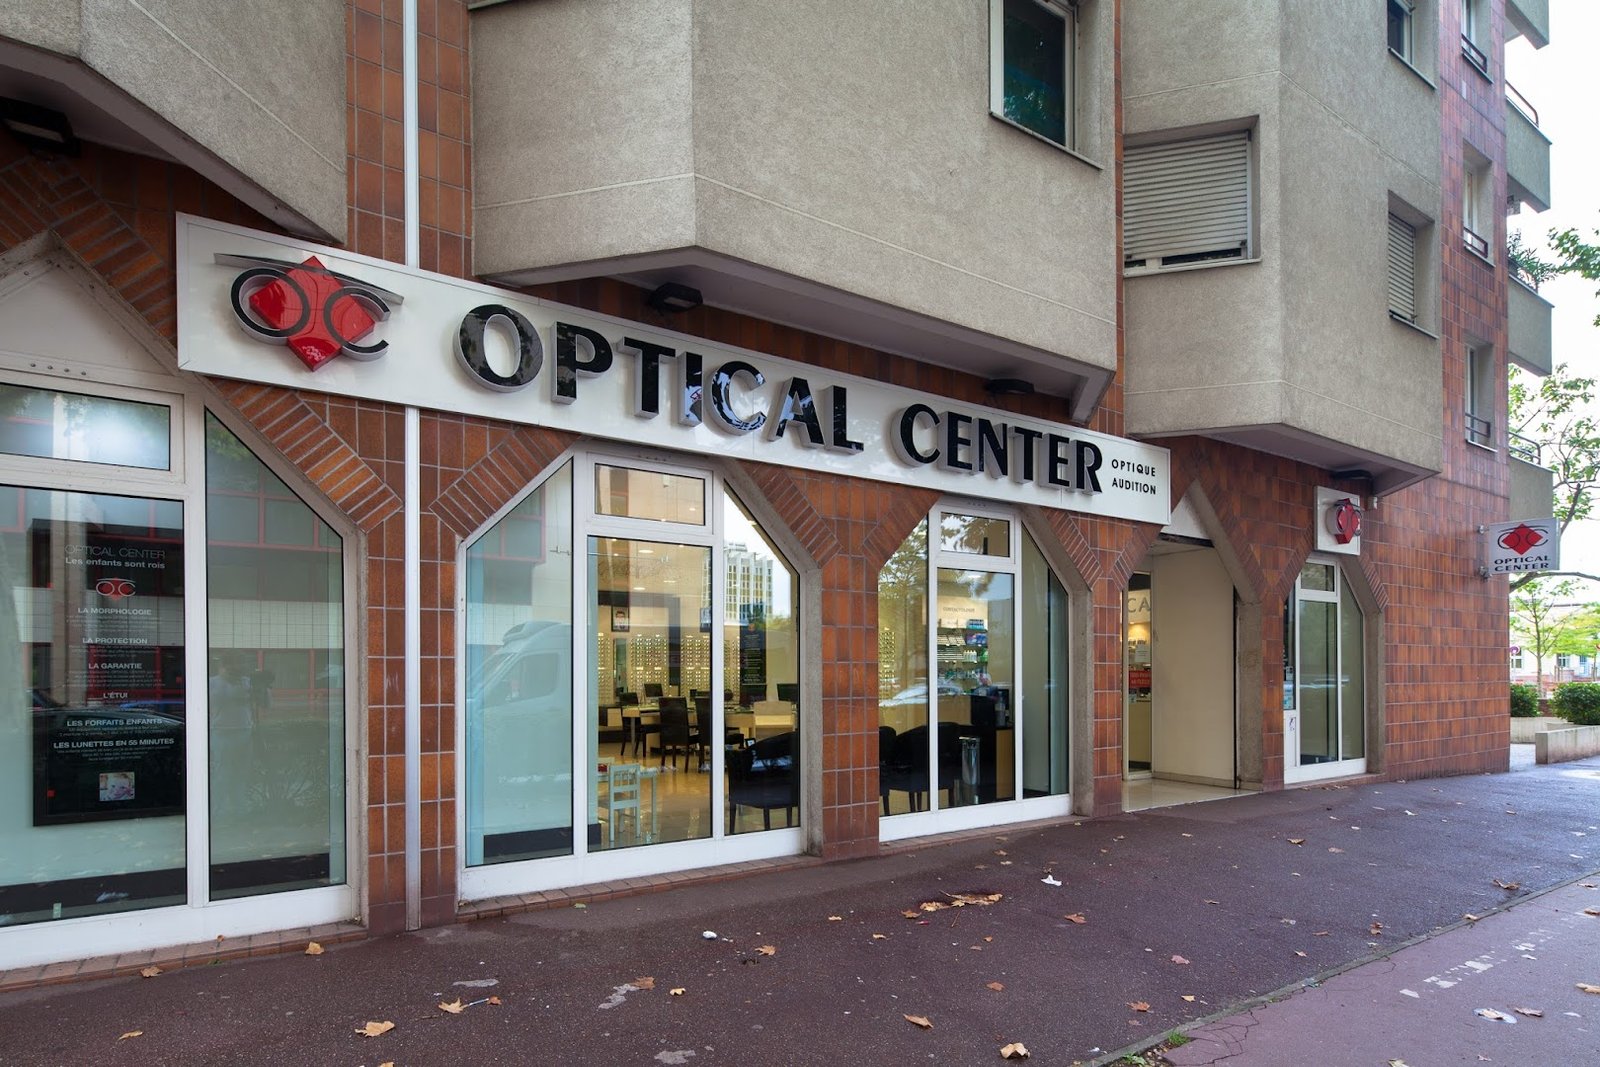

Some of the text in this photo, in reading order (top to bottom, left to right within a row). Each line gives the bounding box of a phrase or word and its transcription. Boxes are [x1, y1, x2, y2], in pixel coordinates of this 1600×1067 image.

[453, 303, 1103, 496] OPTICAL CENTER
[1111, 458, 1156, 477] OPTIQUE
[1111, 477, 1157, 496] AUDITION
[64, 544, 166, 559] OPTICAL CENTER
[65, 556, 166, 569] Les enfants sont rois
[1494, 555, 1551, 565] OPTICAL
[1494, 563, 1549, 572] CENTER
[90, 607, 153, 615] MORPHOLOGIE
[84, 719, 125, 727] FORFAITS
[53, 741, 70, 749] LES
[71, 740, 114, 748] LUNETTES
[139, 737, 175, 746] MINUTES
